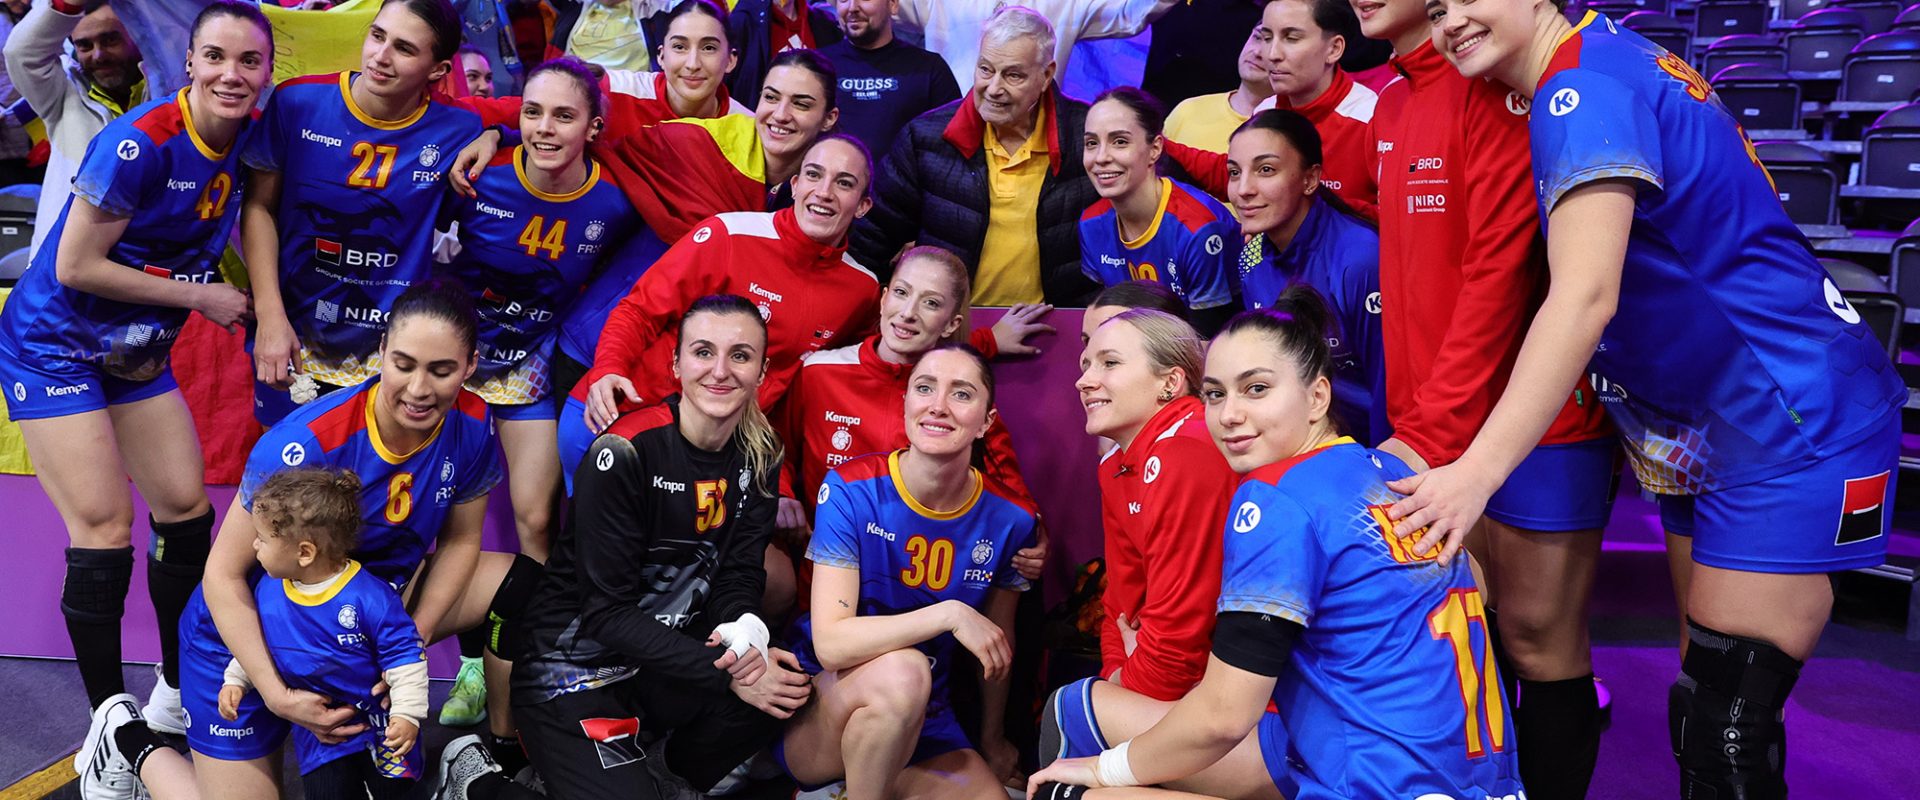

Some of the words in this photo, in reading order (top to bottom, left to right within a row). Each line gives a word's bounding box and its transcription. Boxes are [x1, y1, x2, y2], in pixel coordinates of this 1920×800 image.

[841, 77, 894, 90] GUESS
[301, 128, 342, 148] Kempa
[347, 141, 400, 190] 27
[1417, 157, 1443, 170] BRD
[1320, 180, 1342, 190] RD
[195, 171, 232, 221] 42
[1415, 194, 1446, 206] NIRO
[476, 201, 515, 219] Kempa
[517, 213, 569, 261] 44
[346, 248, 399, 268] BRD
[343, 277, 374, 286] SOCIETE
[749, 282, 782, 303] Kempa
[505, 301, 554, 322] BRD
[45, 383, 90, 398] Kempa
[825, 410, 861, 427] Kempa
[384, 471, 415, 525] 6
[900, 534, 956, 591] 30
[209, 724, 254, 740] Kempa
